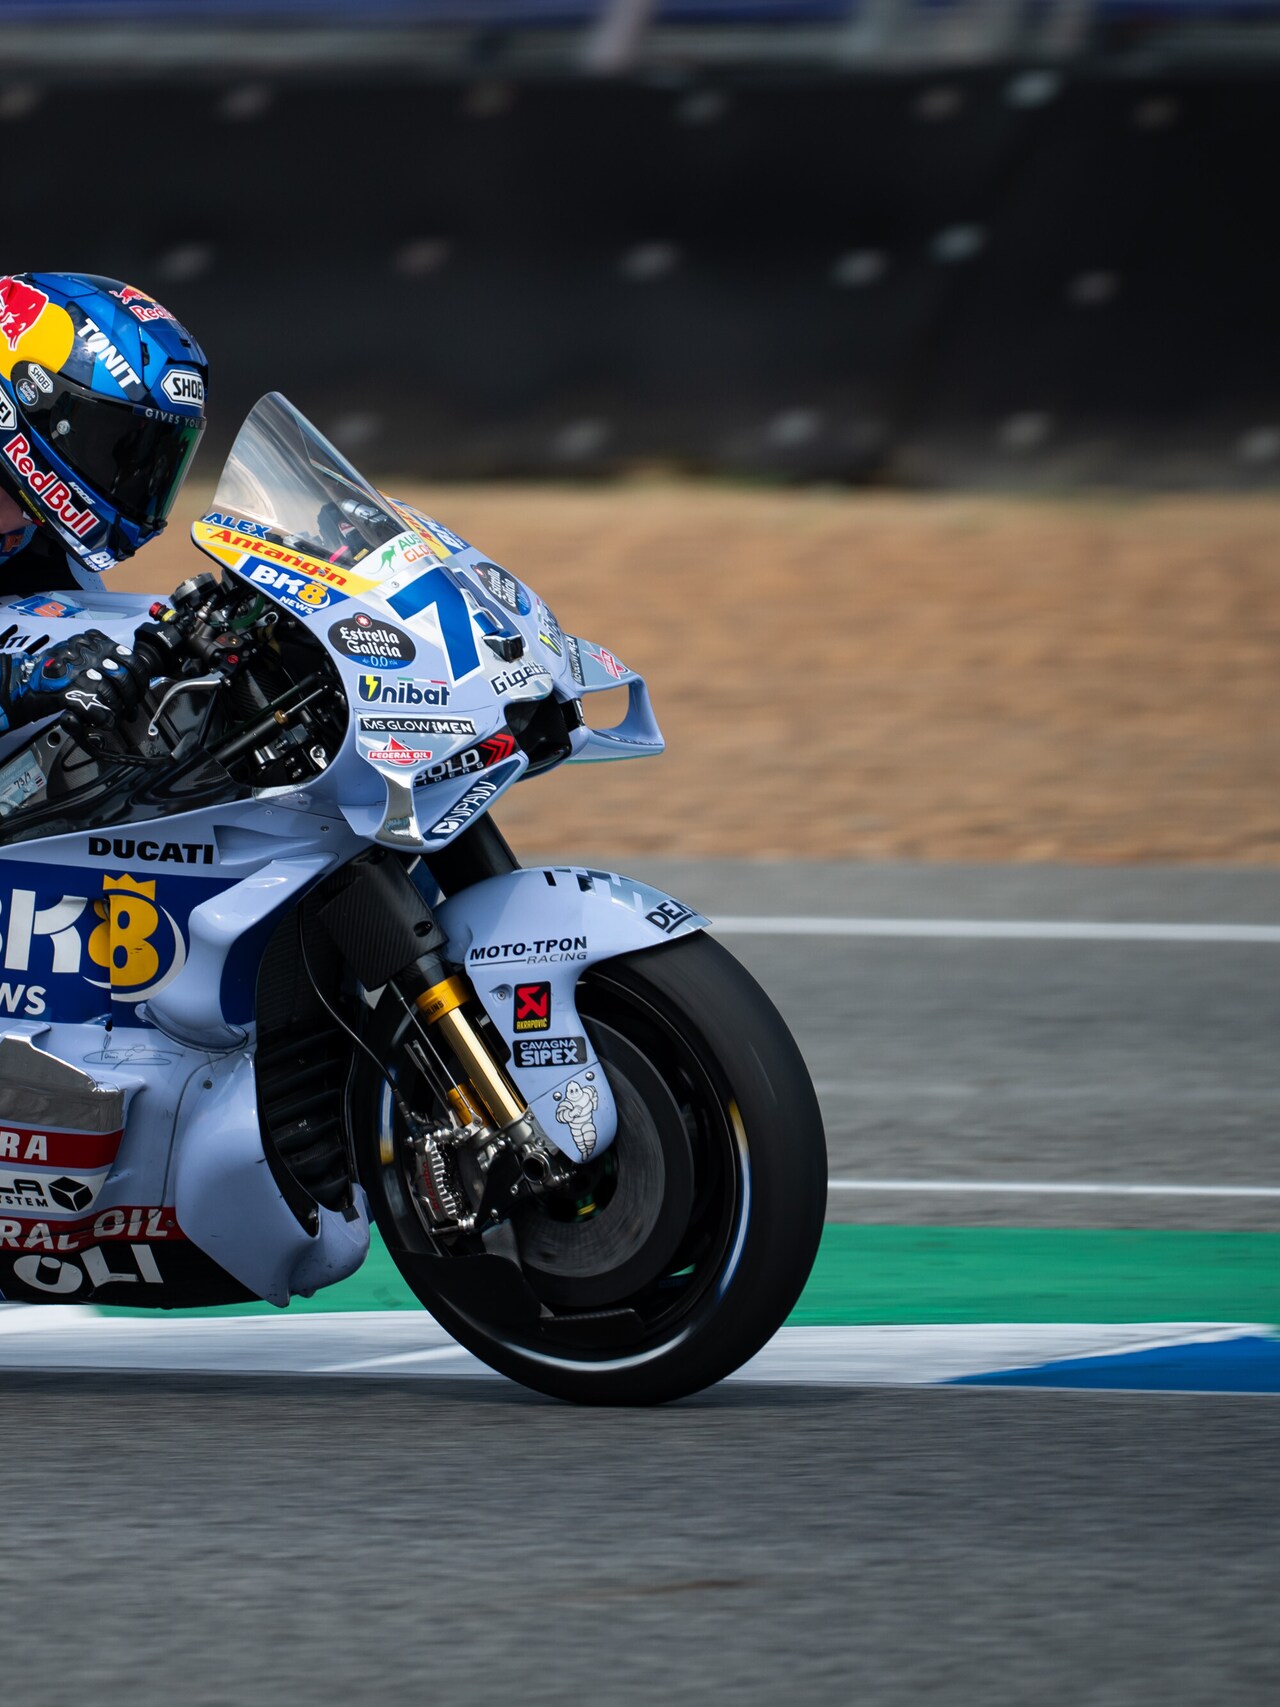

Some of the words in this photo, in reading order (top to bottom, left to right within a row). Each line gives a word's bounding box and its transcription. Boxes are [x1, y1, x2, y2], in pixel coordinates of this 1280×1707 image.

[77, 318, 141, 389] TONIT
[31, 366, 50, 390] SHOEI
[172, 376, 204, 400] SHOE
[145, 408, 180, 424] GIVES
[204, 512, 272, 540] ALEX
[208, 529, 348, 586] Antangin
[248, 563, 331, 609] BK8
[279, 595, 315, 616] NEWS
[339, 626, 400, 645] Estrella
[347, 640, 402, 658] Galicia
[358, 674, 451, 706] Unibat
[386, 720, 430, 732] GLOW
[371, 751, 412, 759] FEDERAL
[88, 836, 215, 865] DUCATI
[469, 936, 587, 961] MOTO-TPON
[526, 952, 588, 965] RACING
[423, 1000, 444, 1016] LINS
[520, 1039, 578, 1050] CAVAGNA
[521, 1049, 579, 1066] SIPEX
[93, 1208, 168, 1238] OIL
